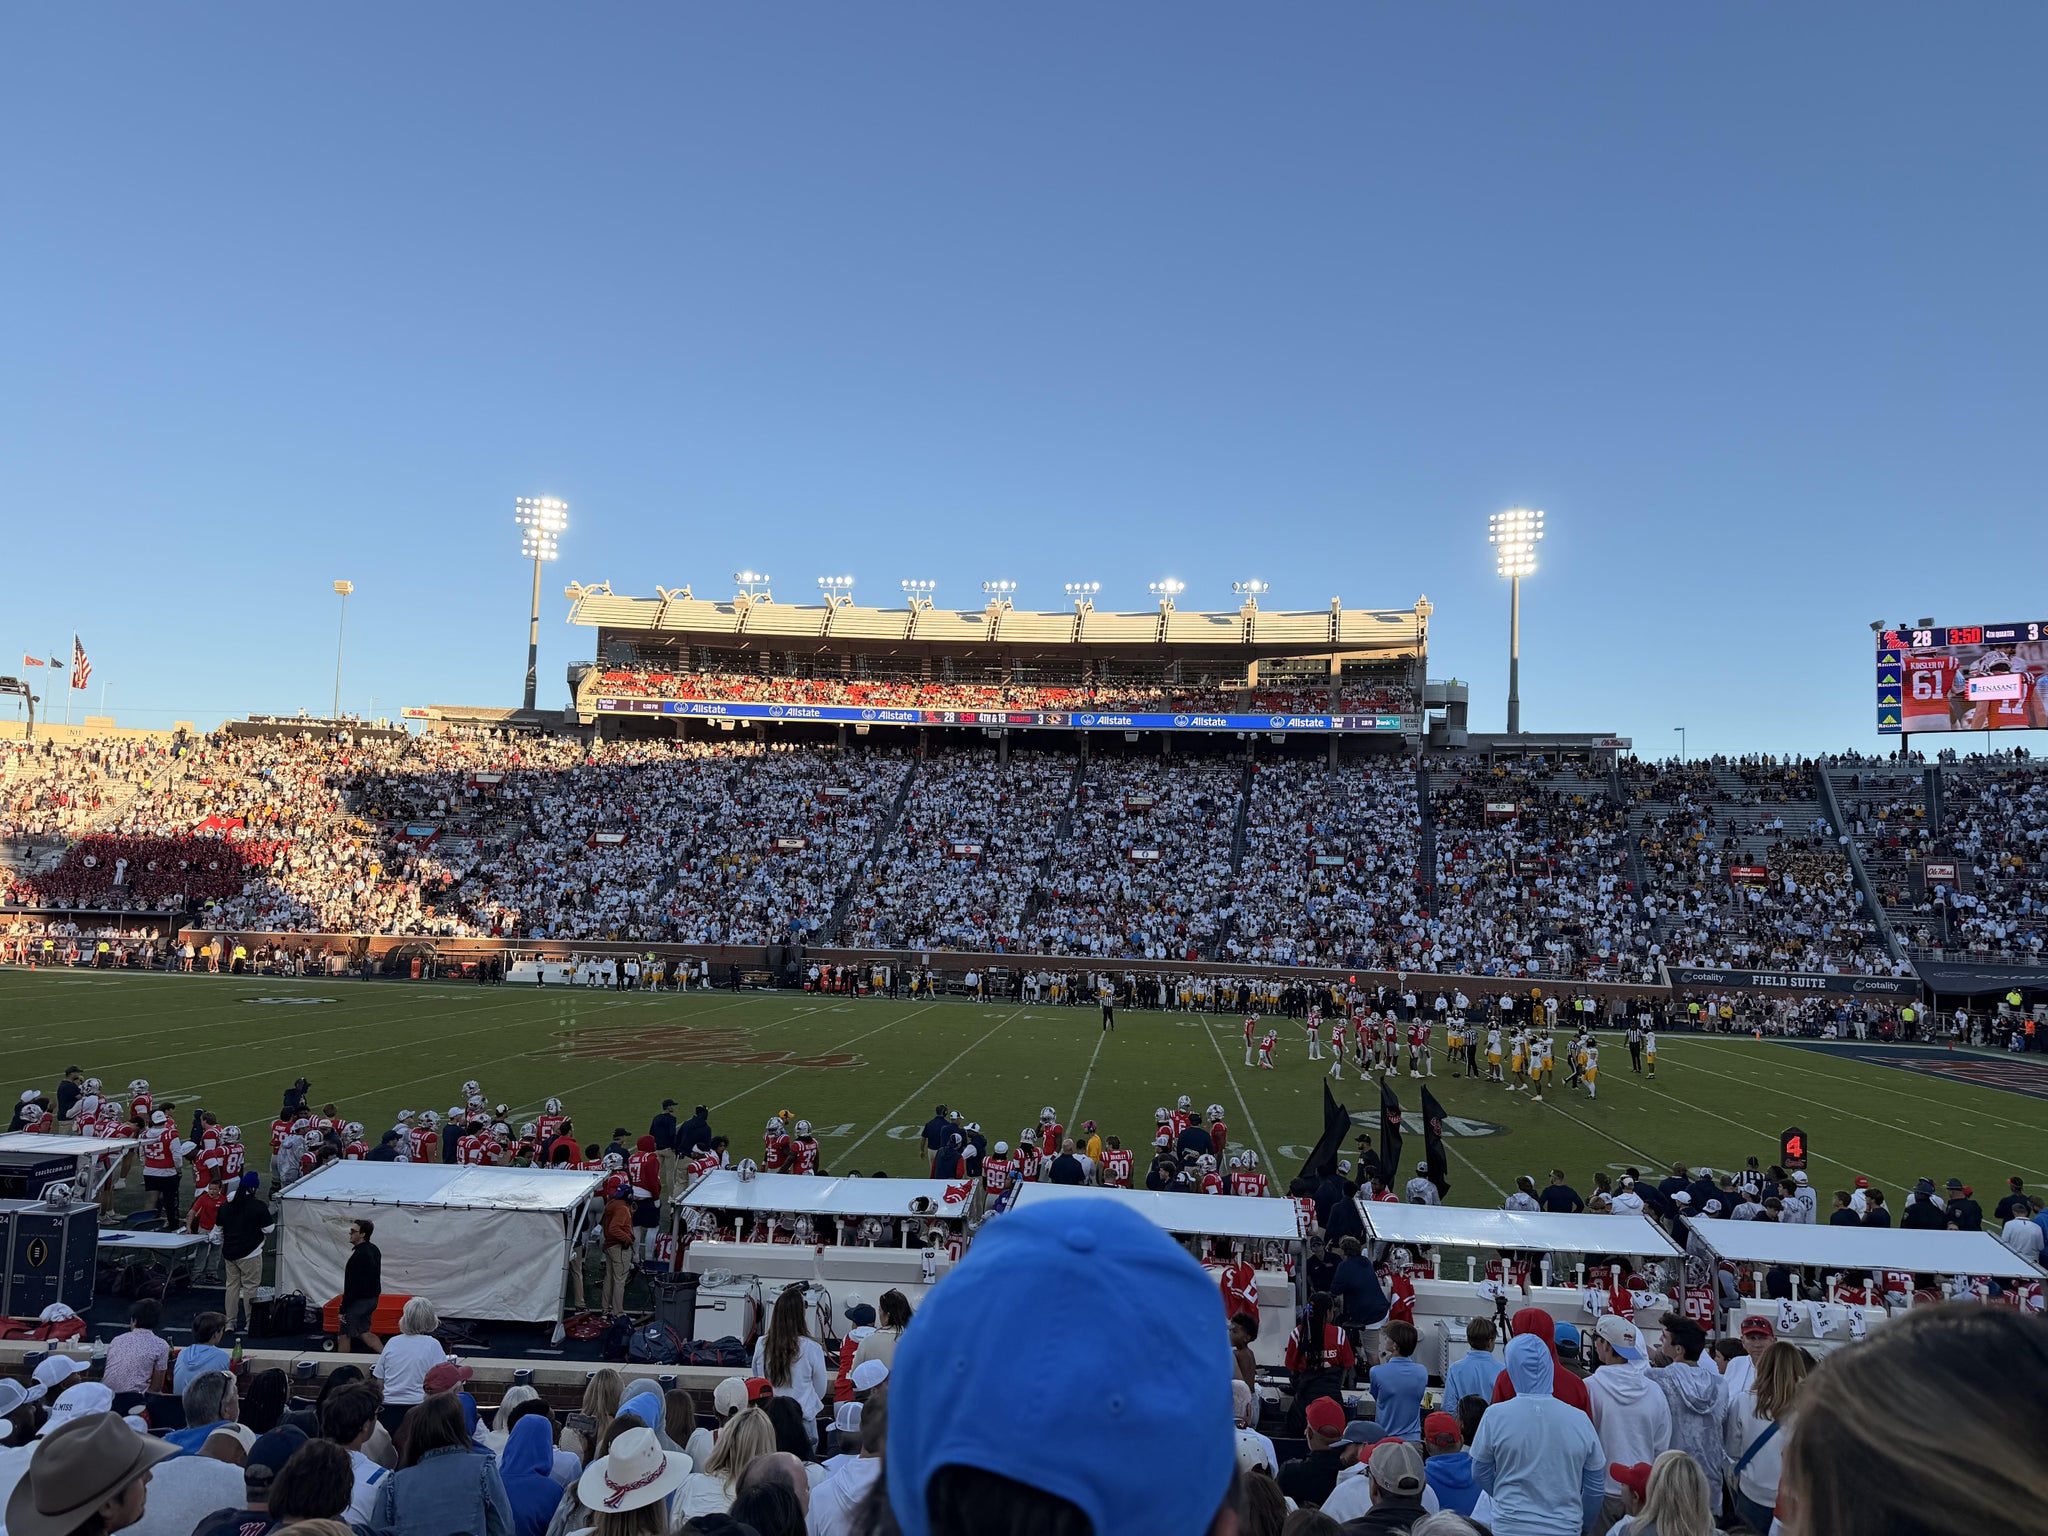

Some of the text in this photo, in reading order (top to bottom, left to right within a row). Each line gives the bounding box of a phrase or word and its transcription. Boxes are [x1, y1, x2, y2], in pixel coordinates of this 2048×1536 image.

[1950, 627, 1981, 644] 3:50
[2028, 623, 2039, 640] 3
[1912, 630, 1932, 647] 28
[1910, 661, 1936, 670] KINSLER
[1912, 670, 1943, 700] 61
[1978, 683, 2017, 692] RENASANT
[690, 704, 727, 714] Allstate
[785, 707, 820, 717] Allstate
[878, 710, 913, 720] Allstate
[944, 712, 954, 722] 28
[960, 713, 975, 722] 3:50
[979, 713, 1006, 723] 4TH & 13
[1037, 714, 1043, 724] 3
[1097, 716, 1131, 725] Allstate
[1191, 717, 1226, 726] Allstate
[1287, 718, 1325, 727] Allstate
[1928, 868, 1952, 876] Ole Miss
[1692, 972, 1724, 983] cotality
[1752, 975, 1825, 989] FIELD SUITE
[1865, 981, 1899, 992] cotality
[1786, 1135, 1803, 1158] 4
[1023, 1157, 1038, 1177] 81
[1237, 1184, 1259, 1196] 42
[0, 1216, 9, 1224] 24
[52, 1218, 63, 1227] 24
[1410, 1264, 1428, 1272] THOMAS
[1685, 1298, 1714, 1321] 95
